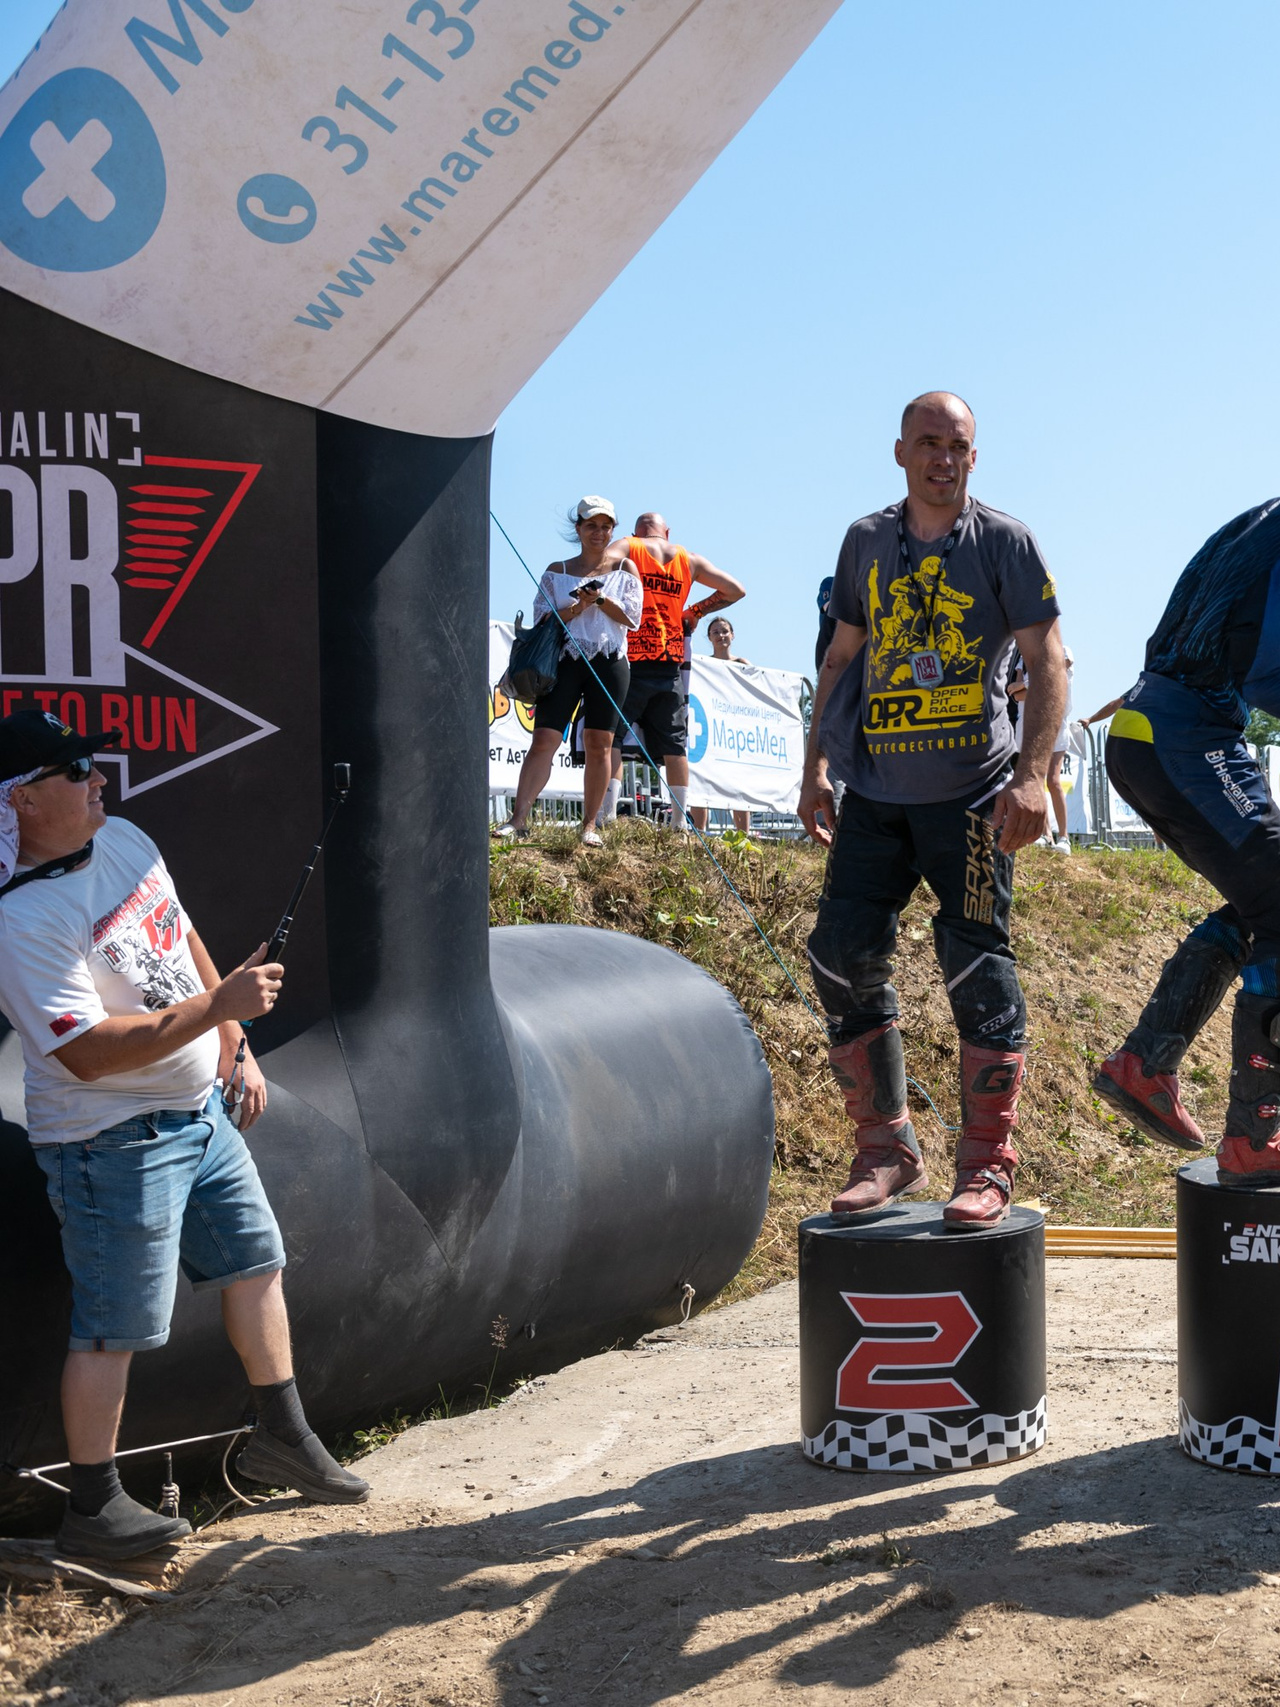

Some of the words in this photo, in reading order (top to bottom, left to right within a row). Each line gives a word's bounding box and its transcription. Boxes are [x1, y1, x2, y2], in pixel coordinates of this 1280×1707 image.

[0, 411, 109, 459] ALIN
[864, 694, 923, 731] OPR
[929, 704, 967, 715] RACE
[930, 697, 951, 707] PIT
[931, 687, 969, 699] OPEN
[101, 693, 197, 753] RUN
[713, 718, 788, 763] МареМед
[964, 809, 981, 921] SAKH
[92, 870, 161, 945] SAKHALIN
[834, 1290, 984, 1414] 2
